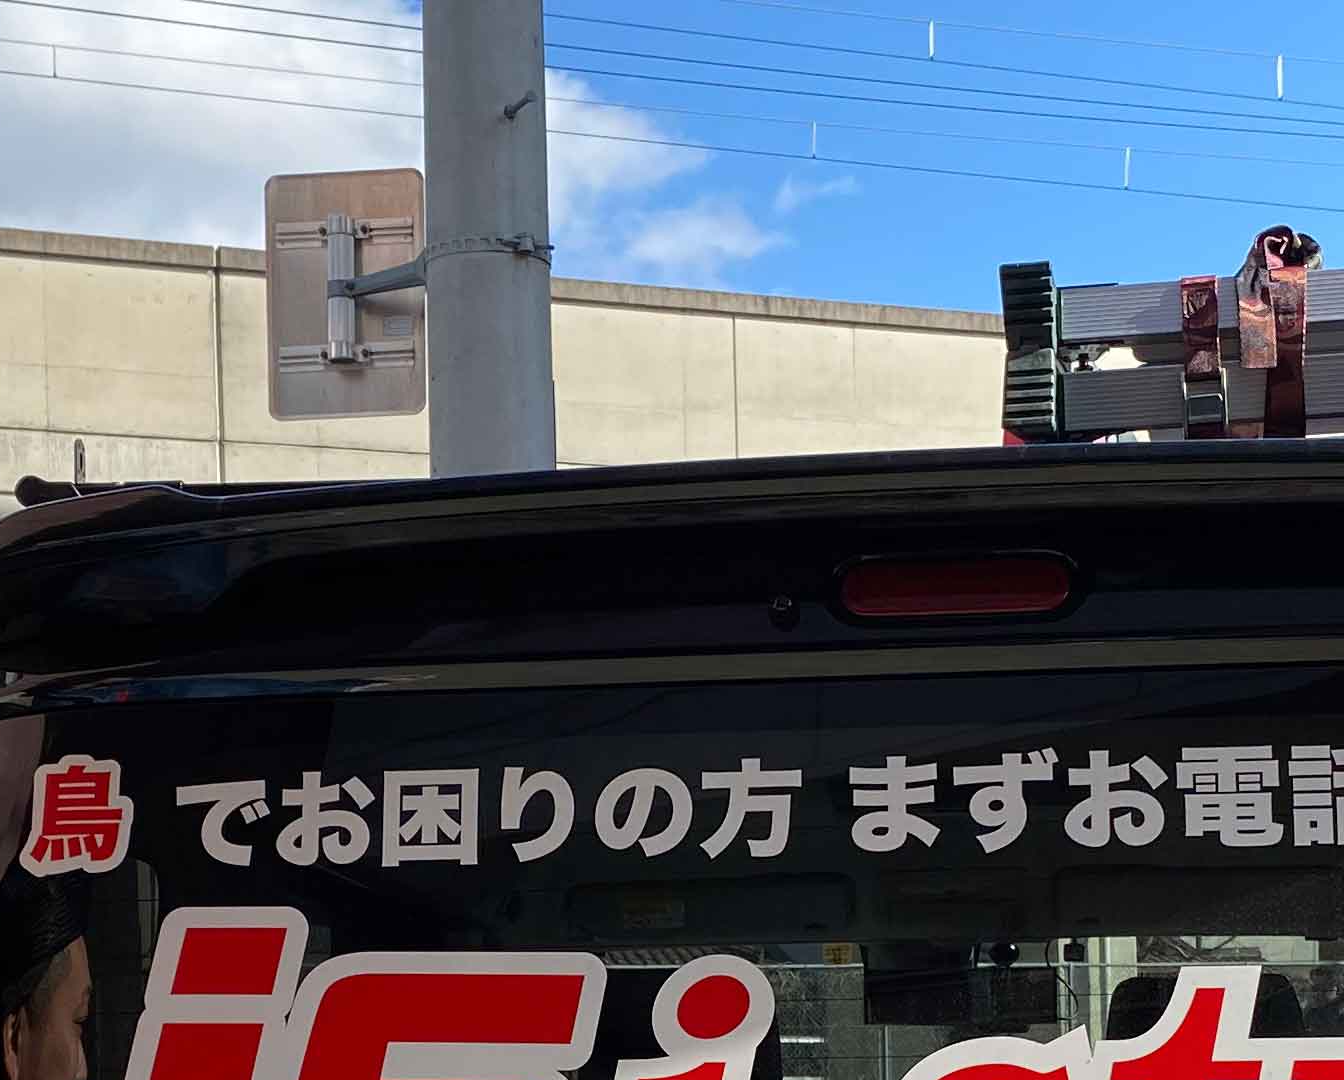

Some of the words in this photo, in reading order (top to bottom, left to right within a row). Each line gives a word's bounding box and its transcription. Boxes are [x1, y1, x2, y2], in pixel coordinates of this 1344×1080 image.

[28, 763, 124, 866] 鳥
[175, 757, 803, 868] でお困りの方
